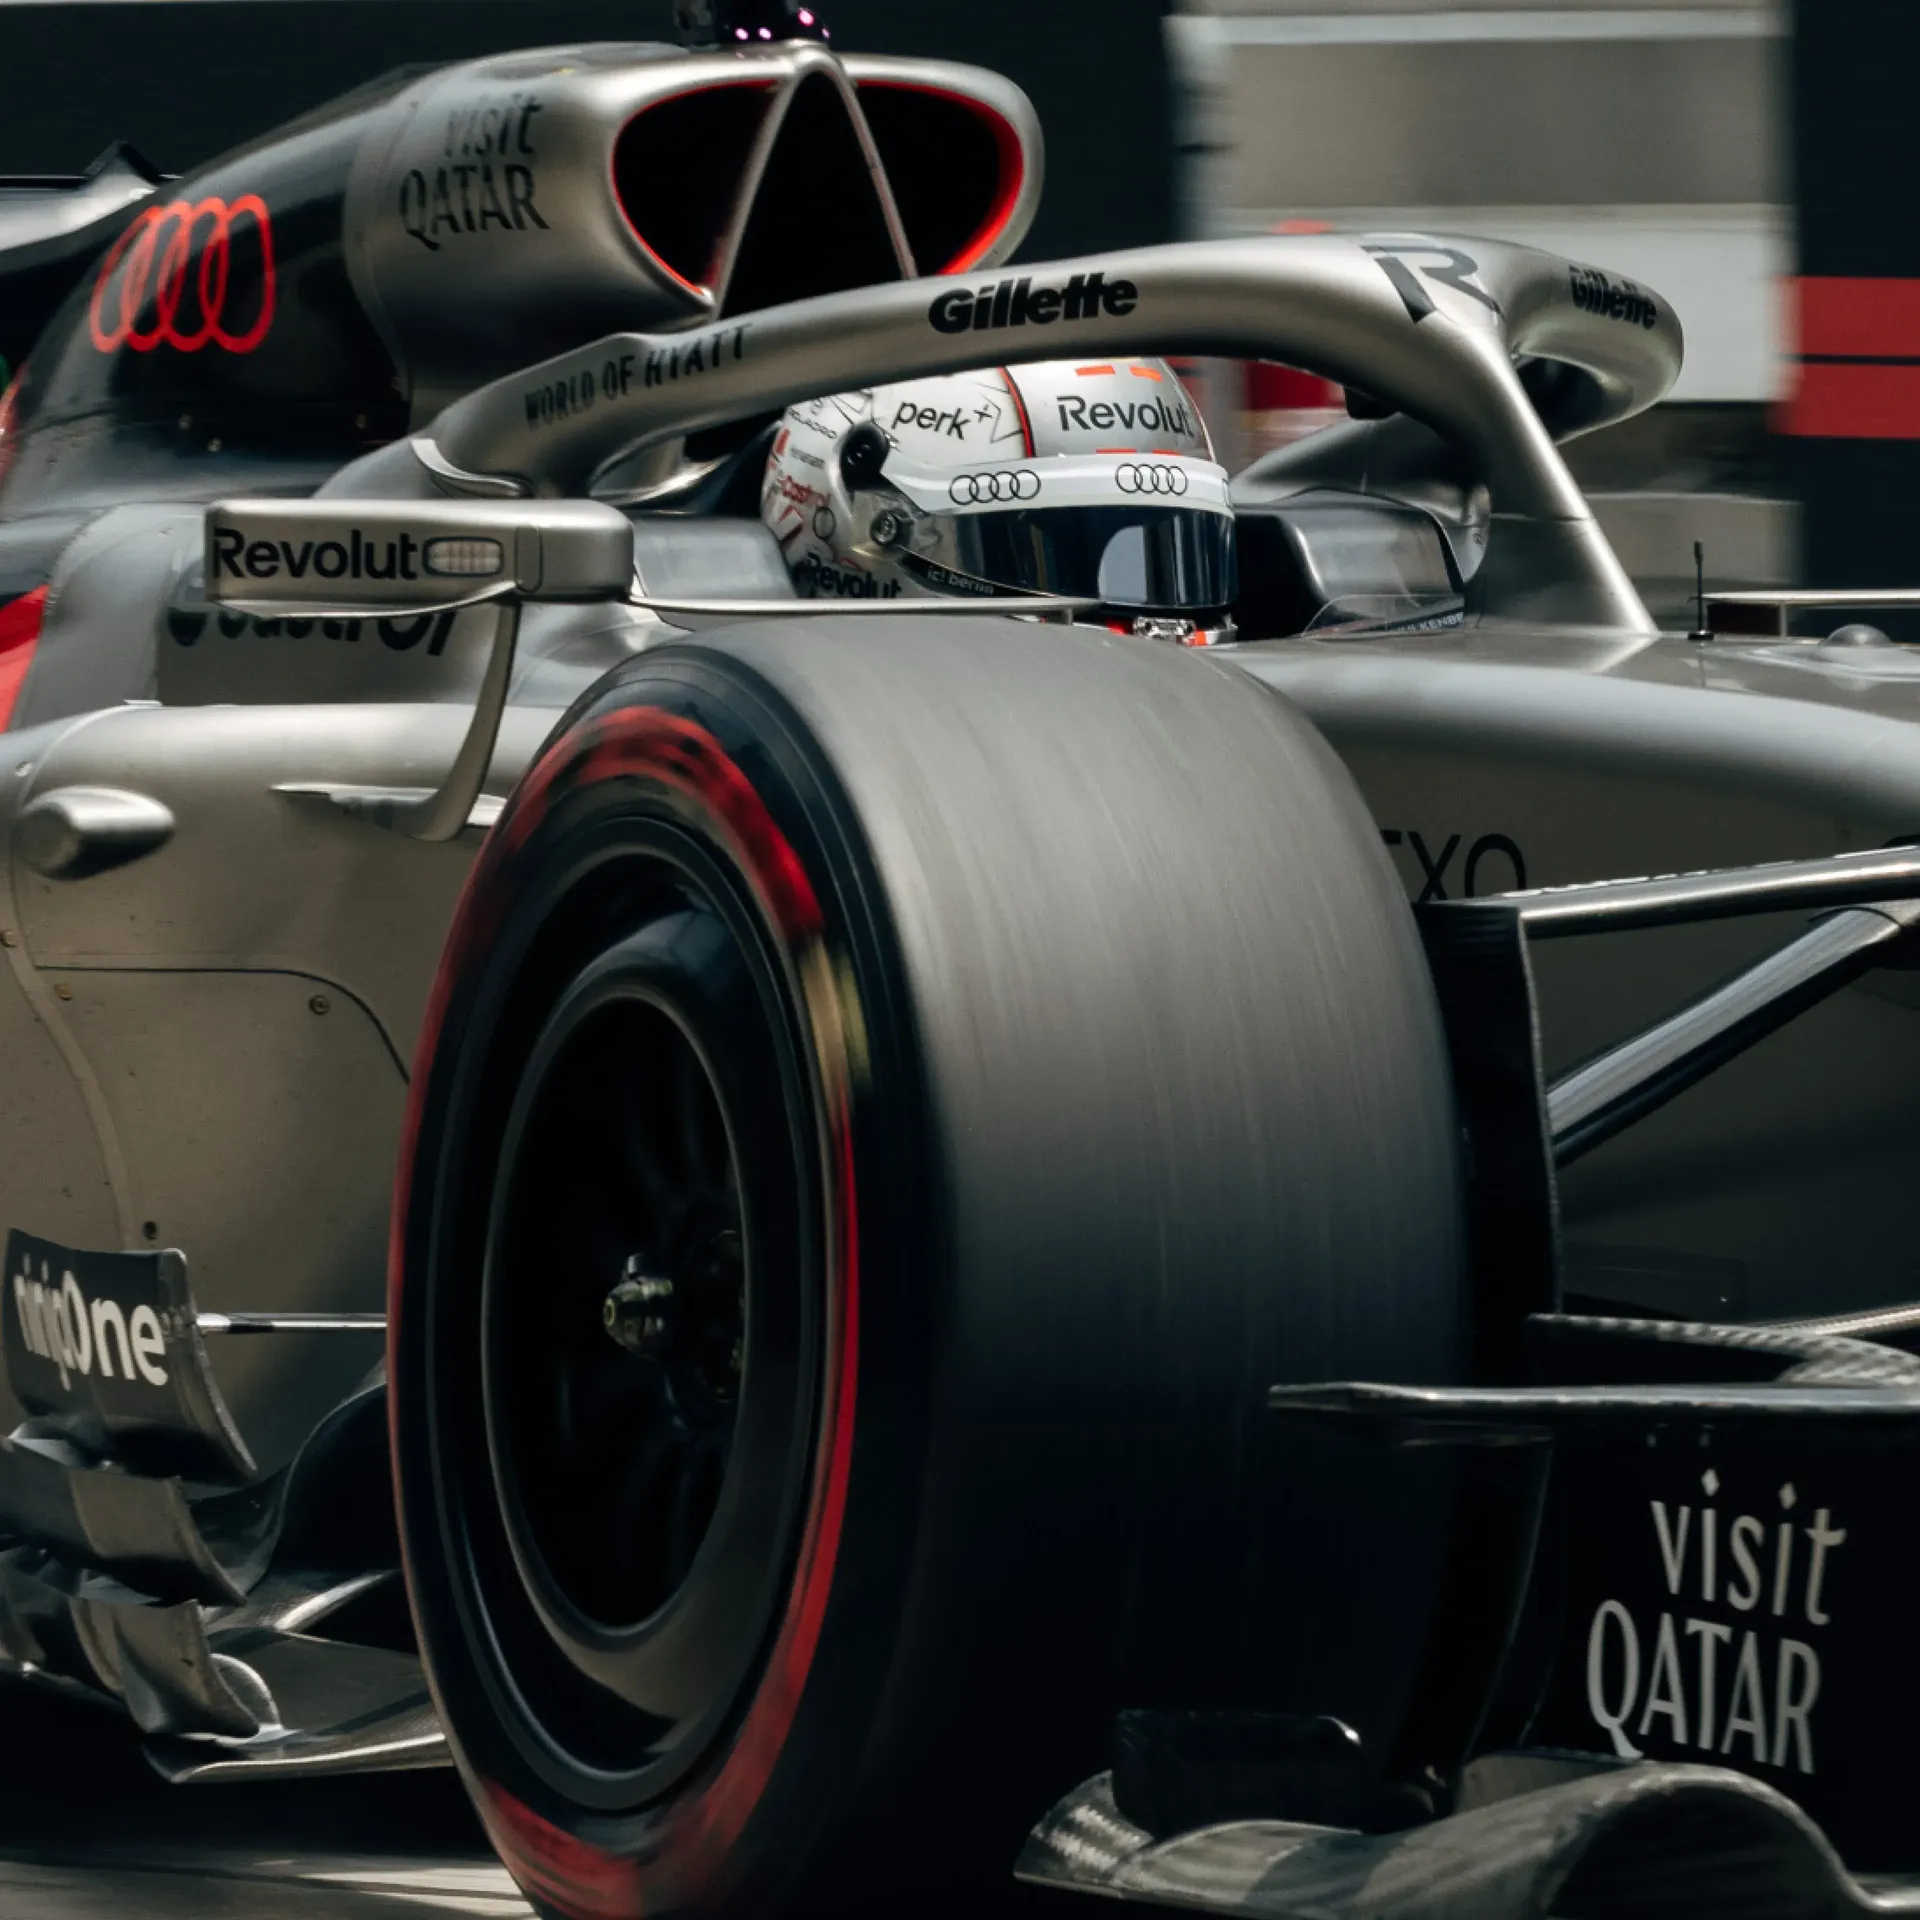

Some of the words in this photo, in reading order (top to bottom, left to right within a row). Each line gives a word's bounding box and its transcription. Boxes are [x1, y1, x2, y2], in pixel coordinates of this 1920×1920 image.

[400, 164, 551, 251] QATAR
[928, 272, 1138, 334] Gillette
[1568, 264, 1658, 330] Gillette
[525, 370, 596, 430] WORLD
[602, 355, 634, 401] OF
[645, 323, 753, 388] HYATT
[891, 401, 972, 440] perk
[1056, 396, 1195, 438] Revolut
[212, 527, 418, 580] Revolut
[1381, 829, 1526, 901] XO
[1650, 1468, 1847, 1627] visit
[1587, 1599, 1821, 1775] QATAR
